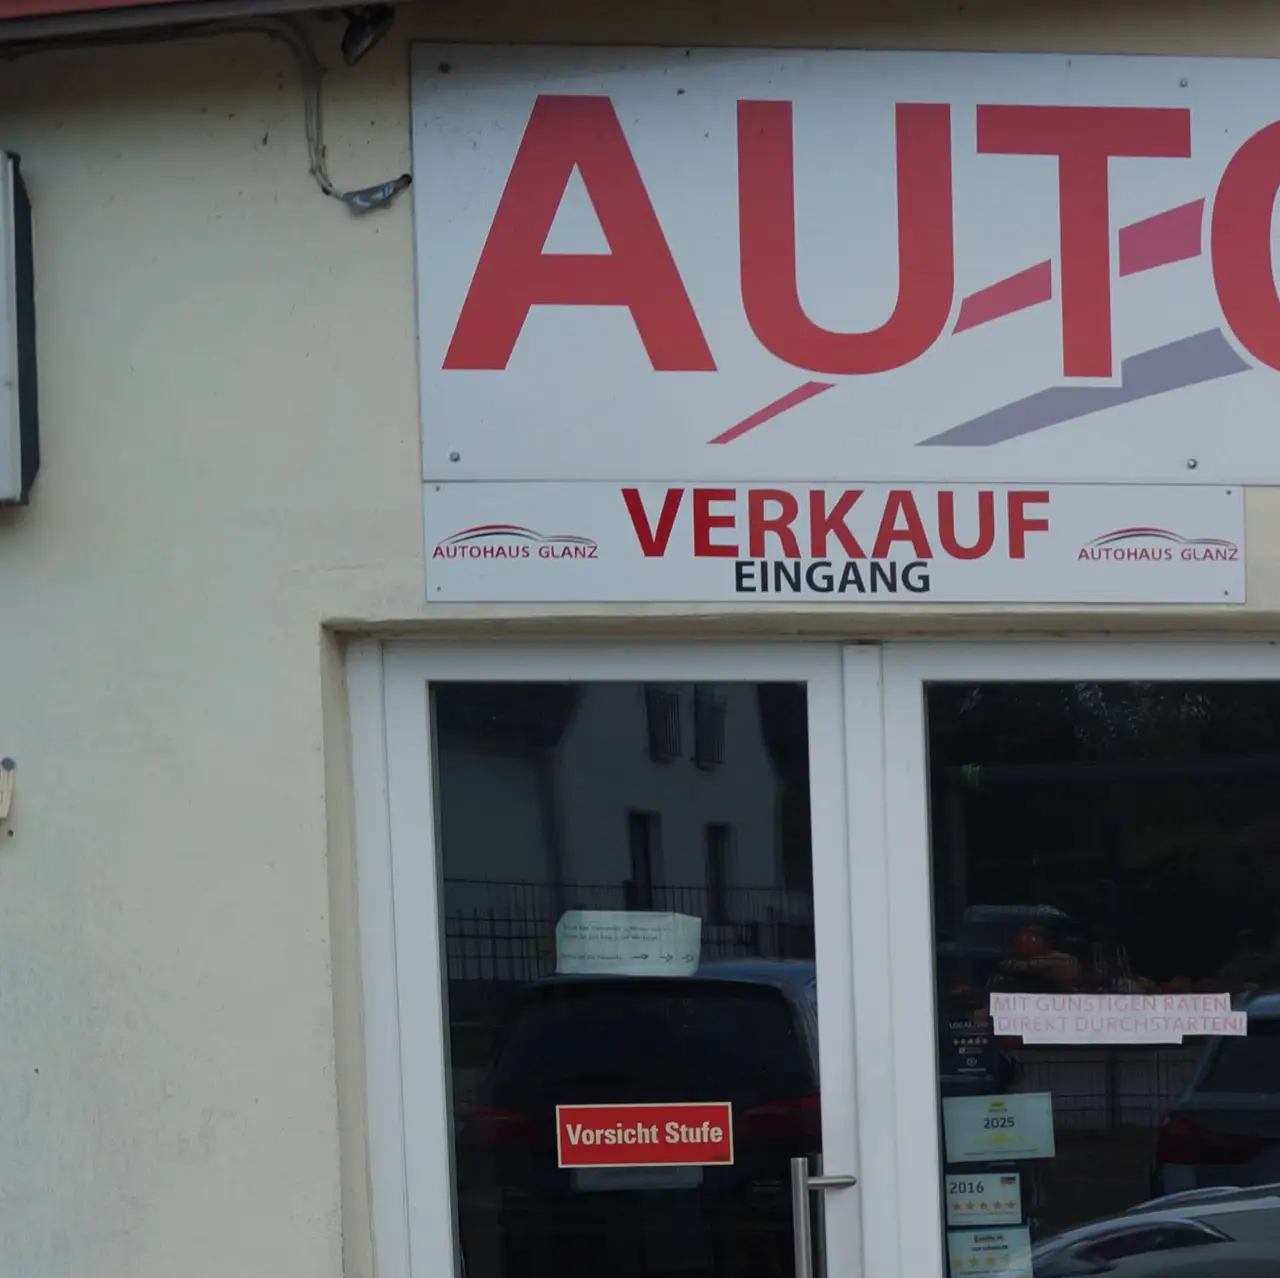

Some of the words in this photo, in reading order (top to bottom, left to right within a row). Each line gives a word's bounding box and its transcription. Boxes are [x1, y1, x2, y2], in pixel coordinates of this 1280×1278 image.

[621, 487, 1050, 560] VERKAUF
[432, 545, 530, 560] AUTOHAUS
[538, 545, 599, 560] GLANZ
[1077, 547, 1173, 562] AUTOHAUS
[1180, 547, 1240, 562] GLANZ
[734, 560, 931, 594] EINGANG
[993, 996, 1029, 1013] MIT
[1163, 996, 1228, 1012] RATEN
[999, 1016, 1069, 1033] DIREKT
[983, 1116, 1015, 1129] 2025
[566, 1122, 659, 1146] Vorsicht
[665, 1121, 724, 1144] Stufe
[950, 1181, 985, 1195] 2016
